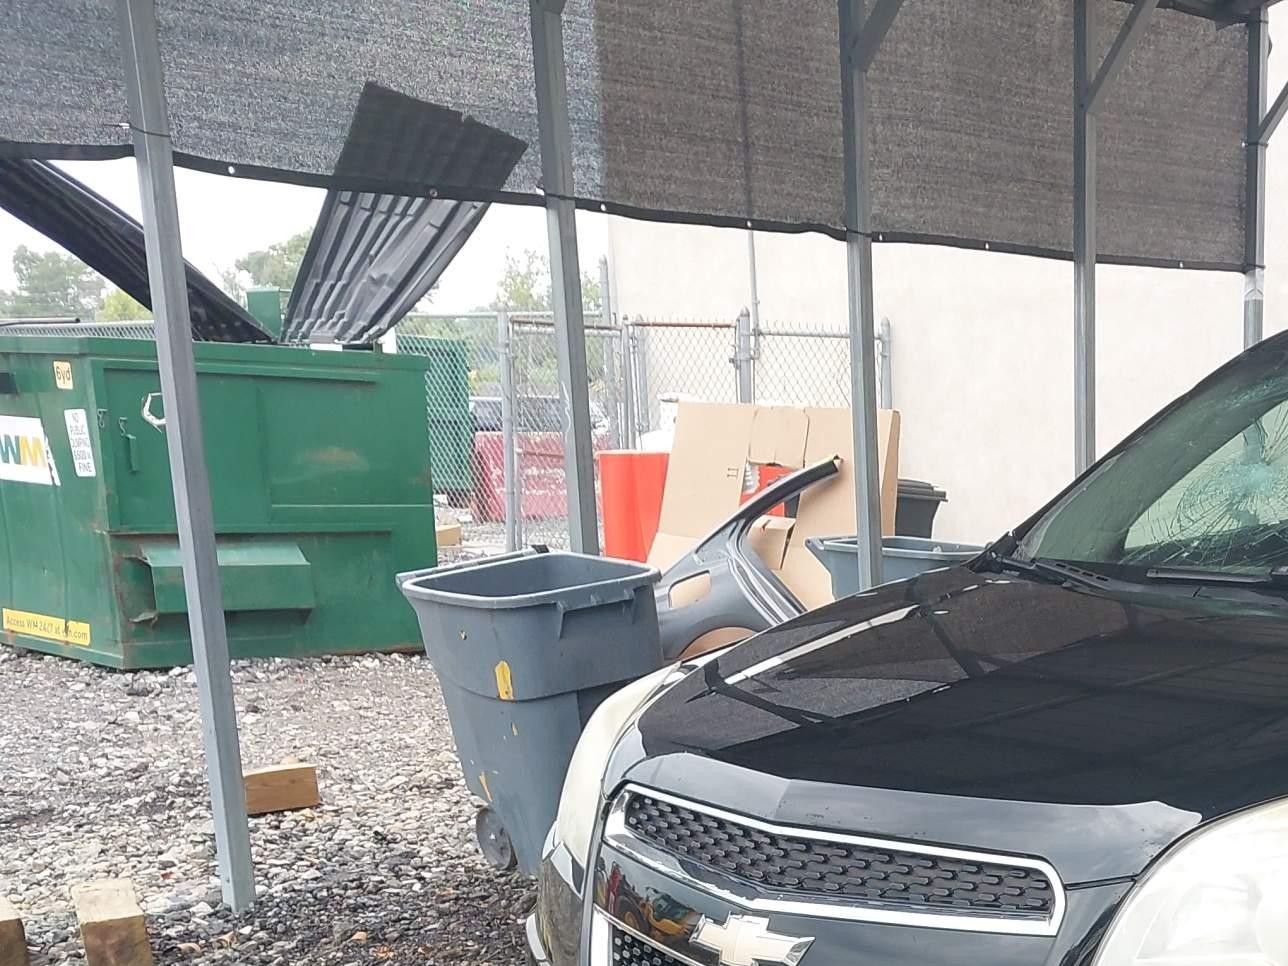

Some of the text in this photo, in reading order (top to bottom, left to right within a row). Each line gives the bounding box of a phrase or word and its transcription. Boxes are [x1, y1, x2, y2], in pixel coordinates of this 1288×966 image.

[56, 365, 71, 385] 6yd
[0, 434, 48, 467] WM
[78, 462, 93, 473] FINE
